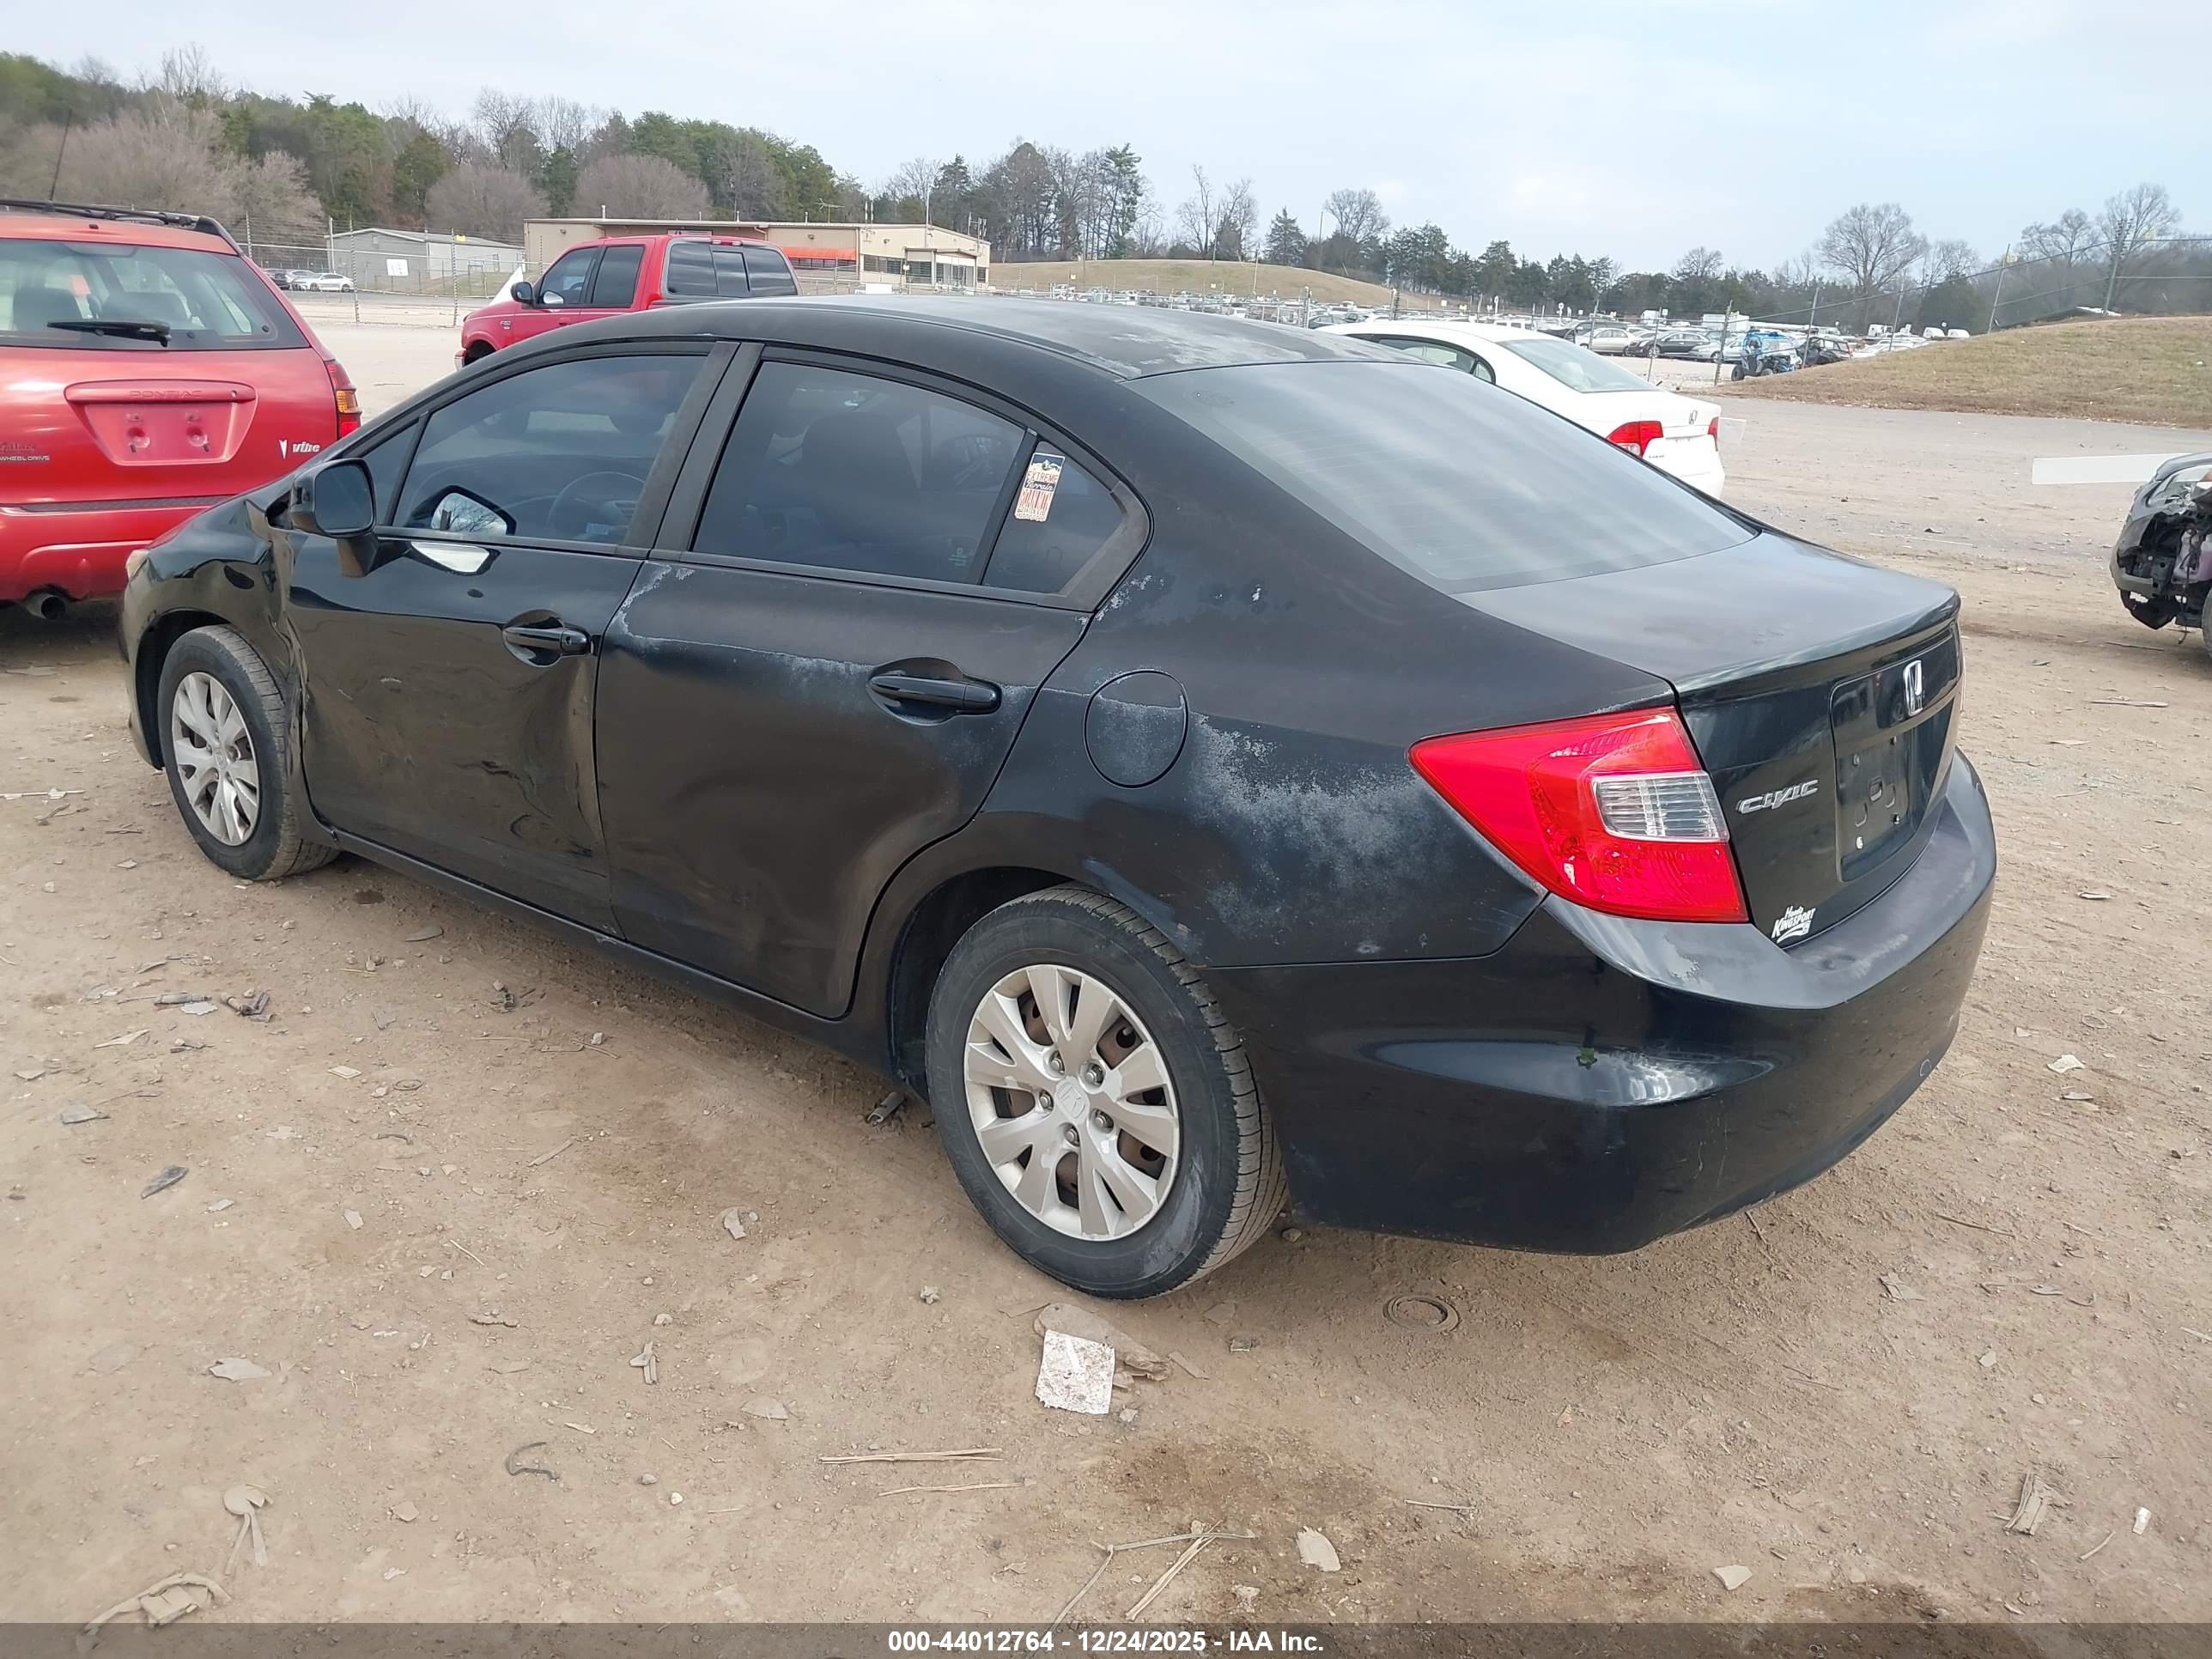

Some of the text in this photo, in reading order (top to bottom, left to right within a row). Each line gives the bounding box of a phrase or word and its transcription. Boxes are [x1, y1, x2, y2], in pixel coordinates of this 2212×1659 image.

[130, 390, 204, 399] PONTIAC
[292, 441, 320, 453] vibe
[1735, 780, 1819, 814] CIVIC
